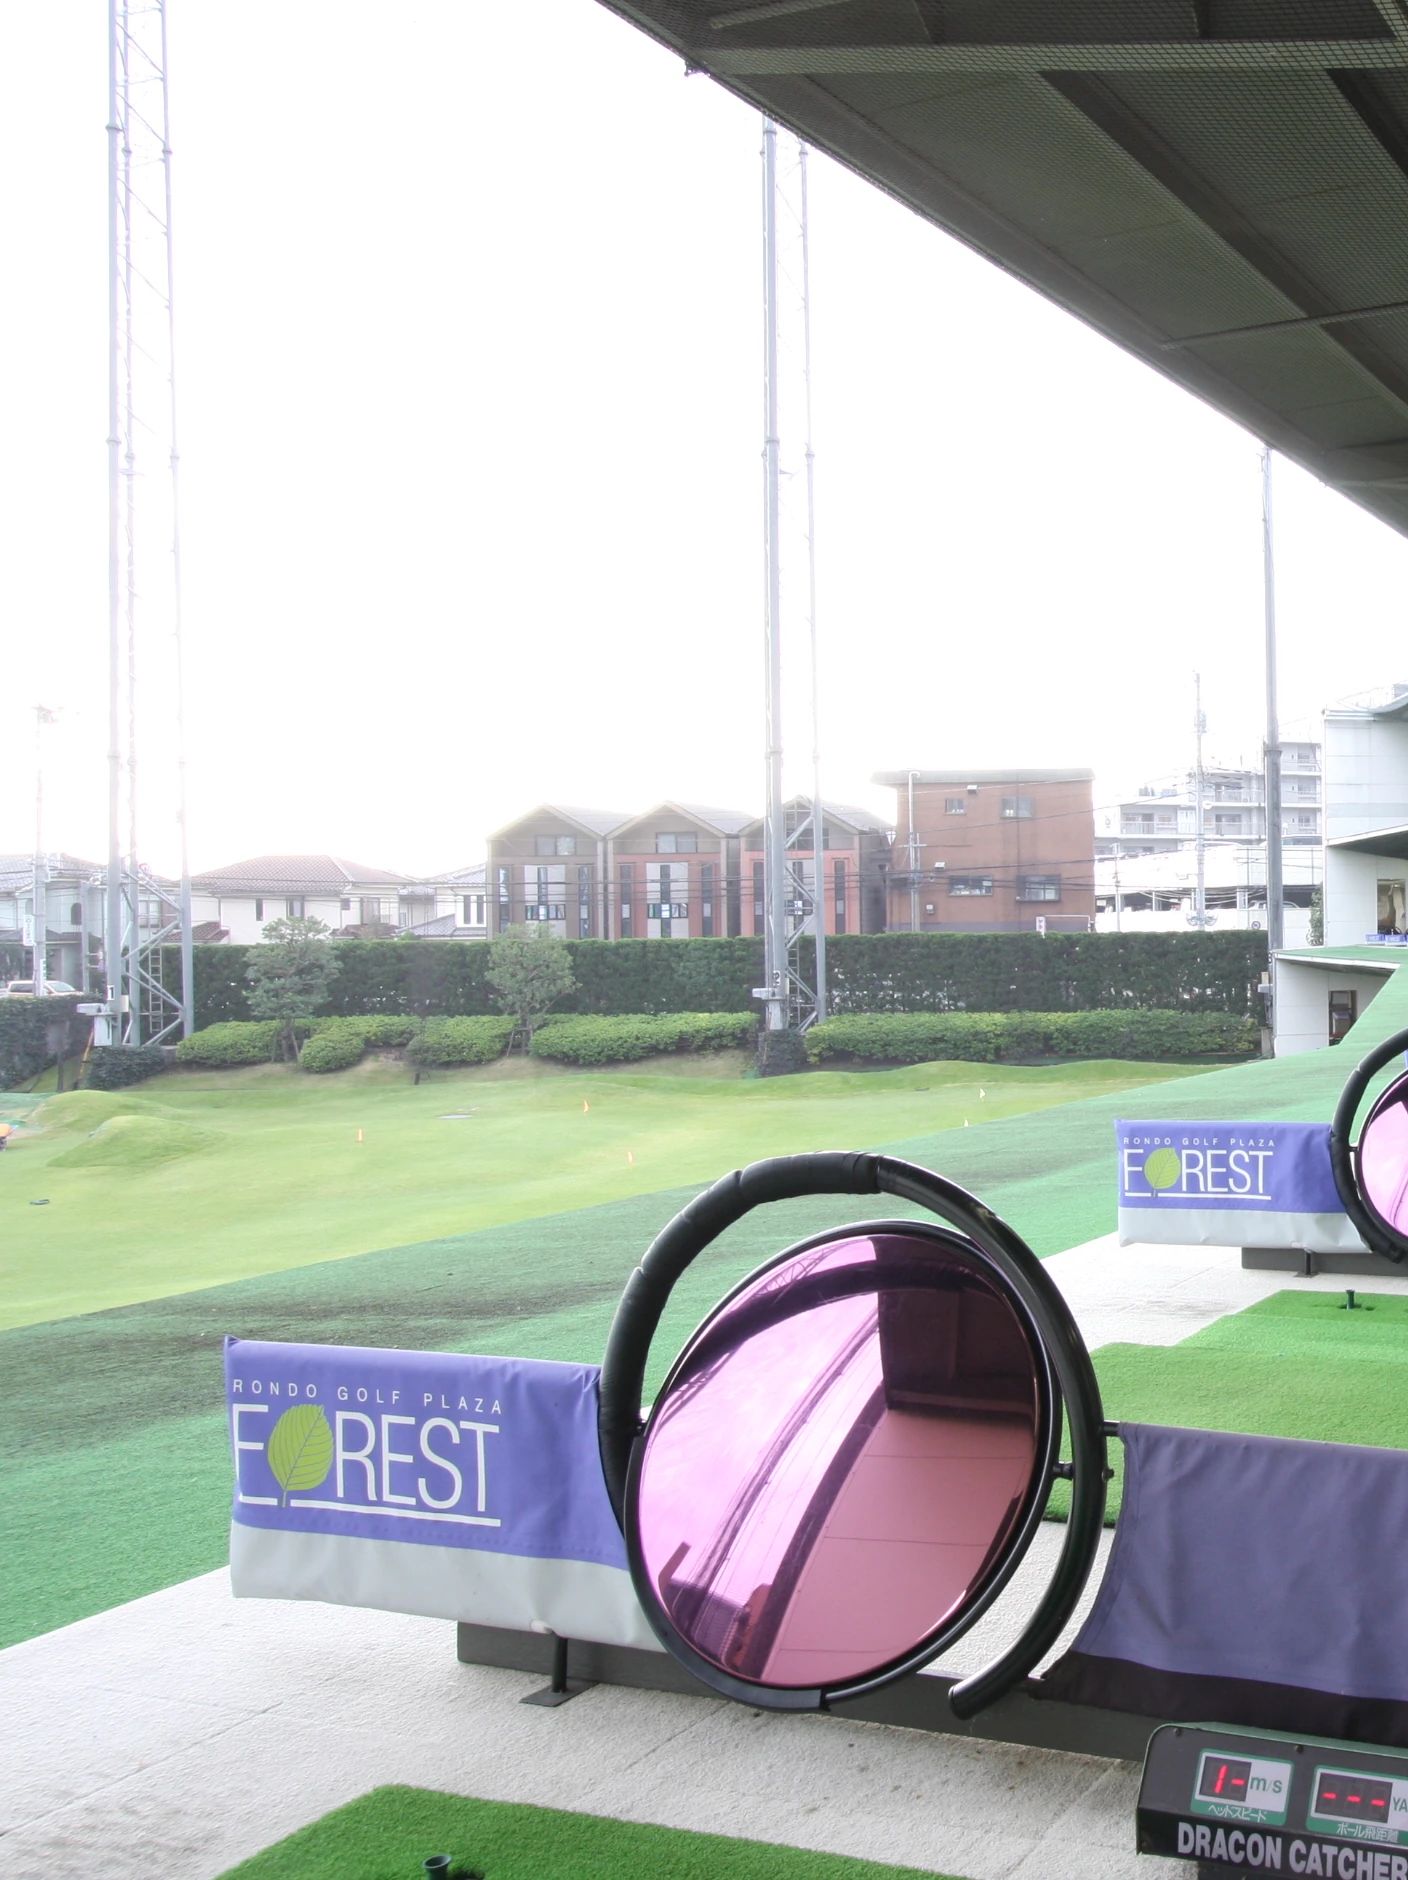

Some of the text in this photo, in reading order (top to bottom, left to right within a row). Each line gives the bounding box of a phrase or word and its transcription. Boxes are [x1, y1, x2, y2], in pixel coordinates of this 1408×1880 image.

[1123, 1137, 1276, 1147] RONDO GOLF PLAZA
[232, 1378, 502, 1415] RONDO GOLF PLAZA
[1250, 1776, 1283, 1793] m/s
[1177, 1820, 1408, 1880] DRACON CATCHER
